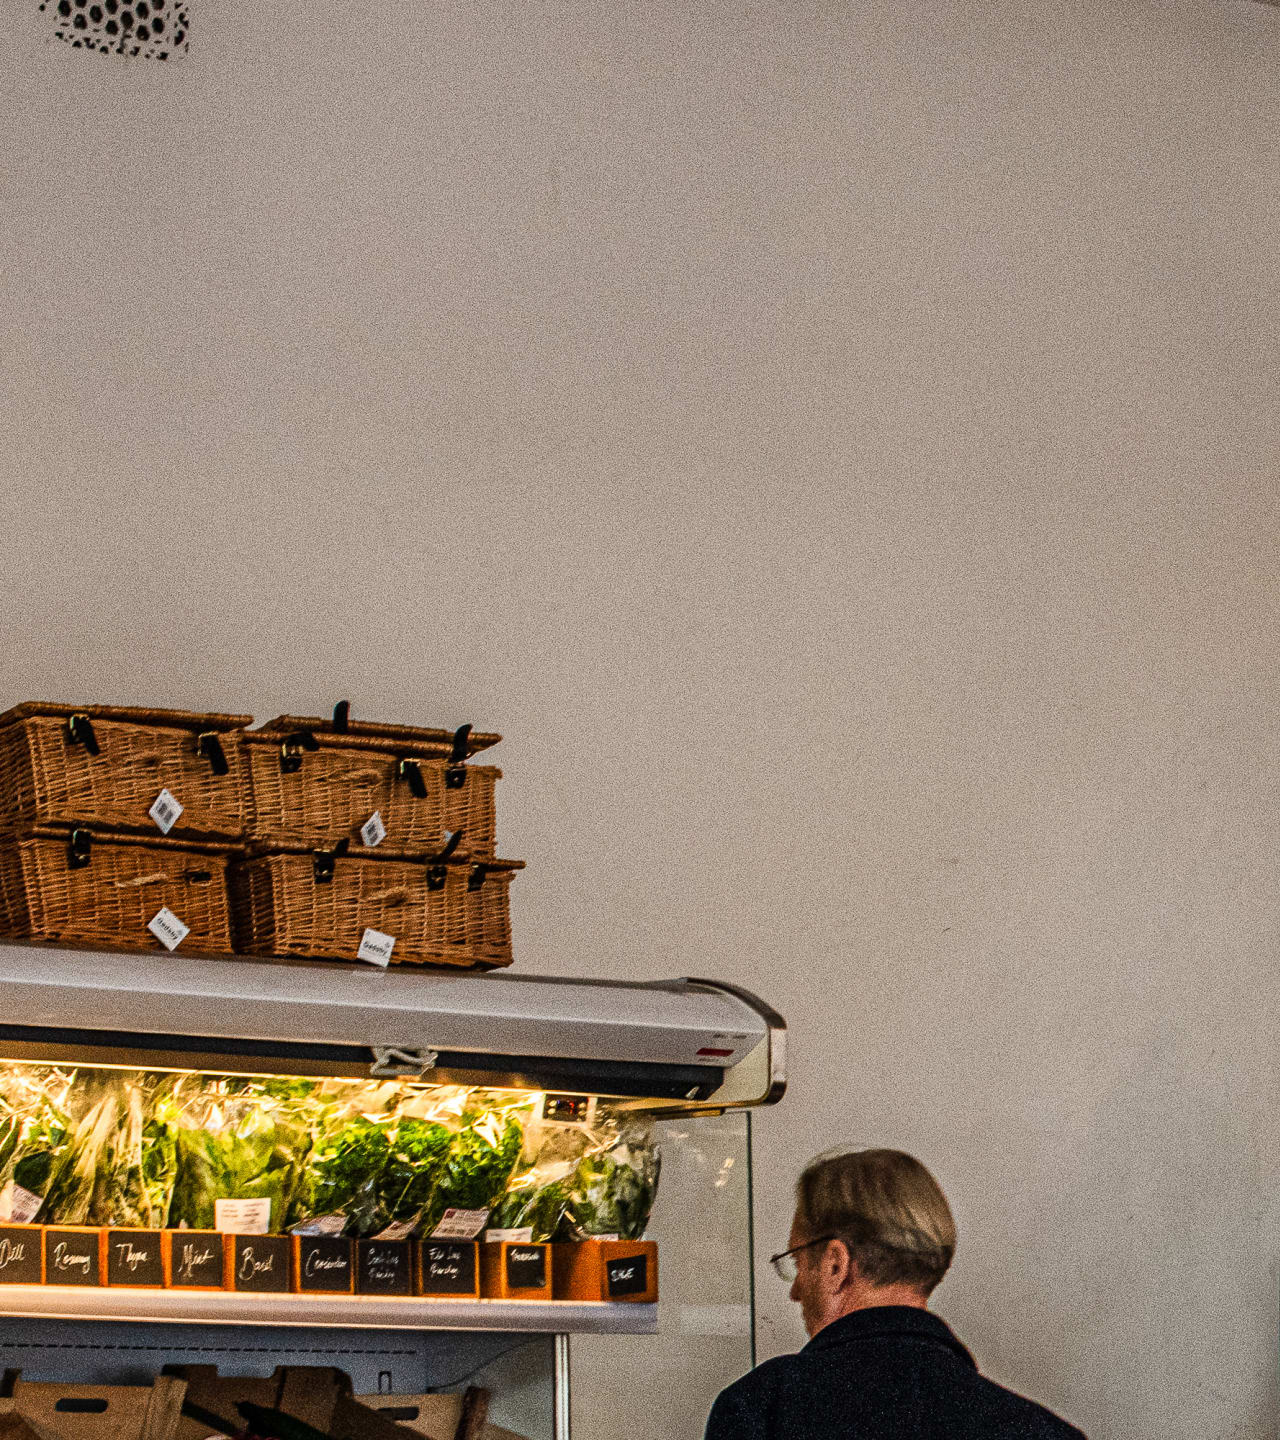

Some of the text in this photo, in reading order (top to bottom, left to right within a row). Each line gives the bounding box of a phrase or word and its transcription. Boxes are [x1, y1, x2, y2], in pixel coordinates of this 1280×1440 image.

[0, 1238, 25, 1269] Dill
[54, 1241, 91, 1275] Rosemary
[116, 1242, 148, 1271] Thyme
[179, 1243, 214, 1278] Mint
[239, 1246, 274, 1281] Basil
